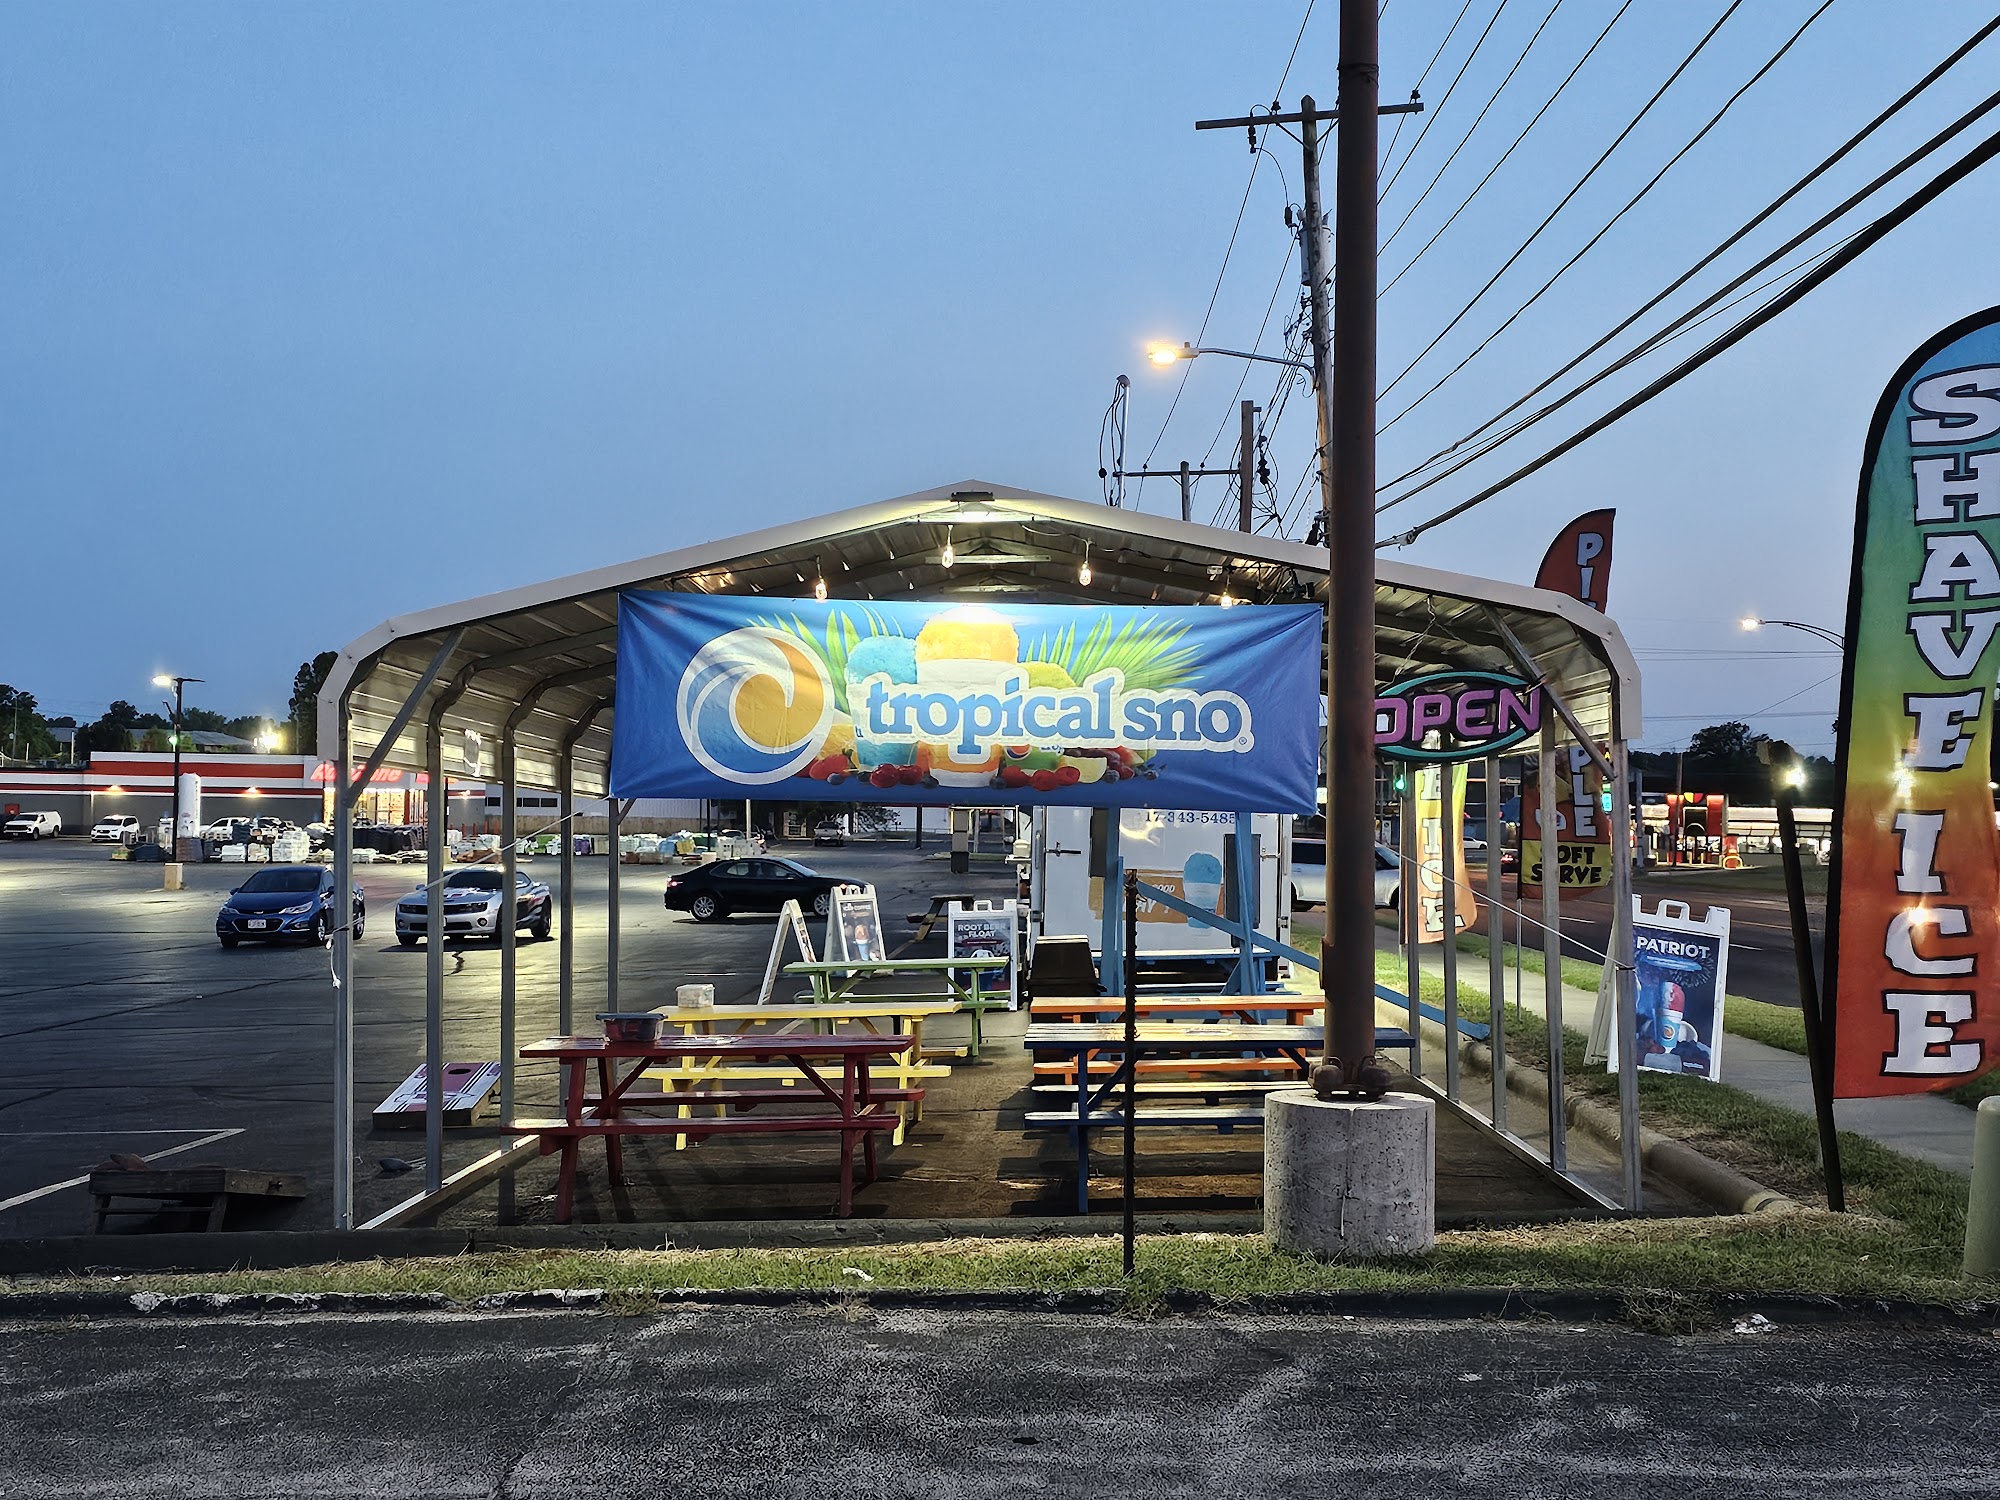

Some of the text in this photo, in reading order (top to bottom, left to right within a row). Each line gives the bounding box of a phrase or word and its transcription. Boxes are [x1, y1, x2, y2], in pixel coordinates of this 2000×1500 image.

[866, 676, 1115, 755] tropical
[1375, 688, 1542, 744] OPEN
[1540, 845, 1595, 864] OFT
[1531, 863, 1602, 884] SRVE
[968, 930, 996, 938] FLOAT
[1880, 808, 1986, 1078] ICE
[1636, 936, 1710, 959] PATRIOT
